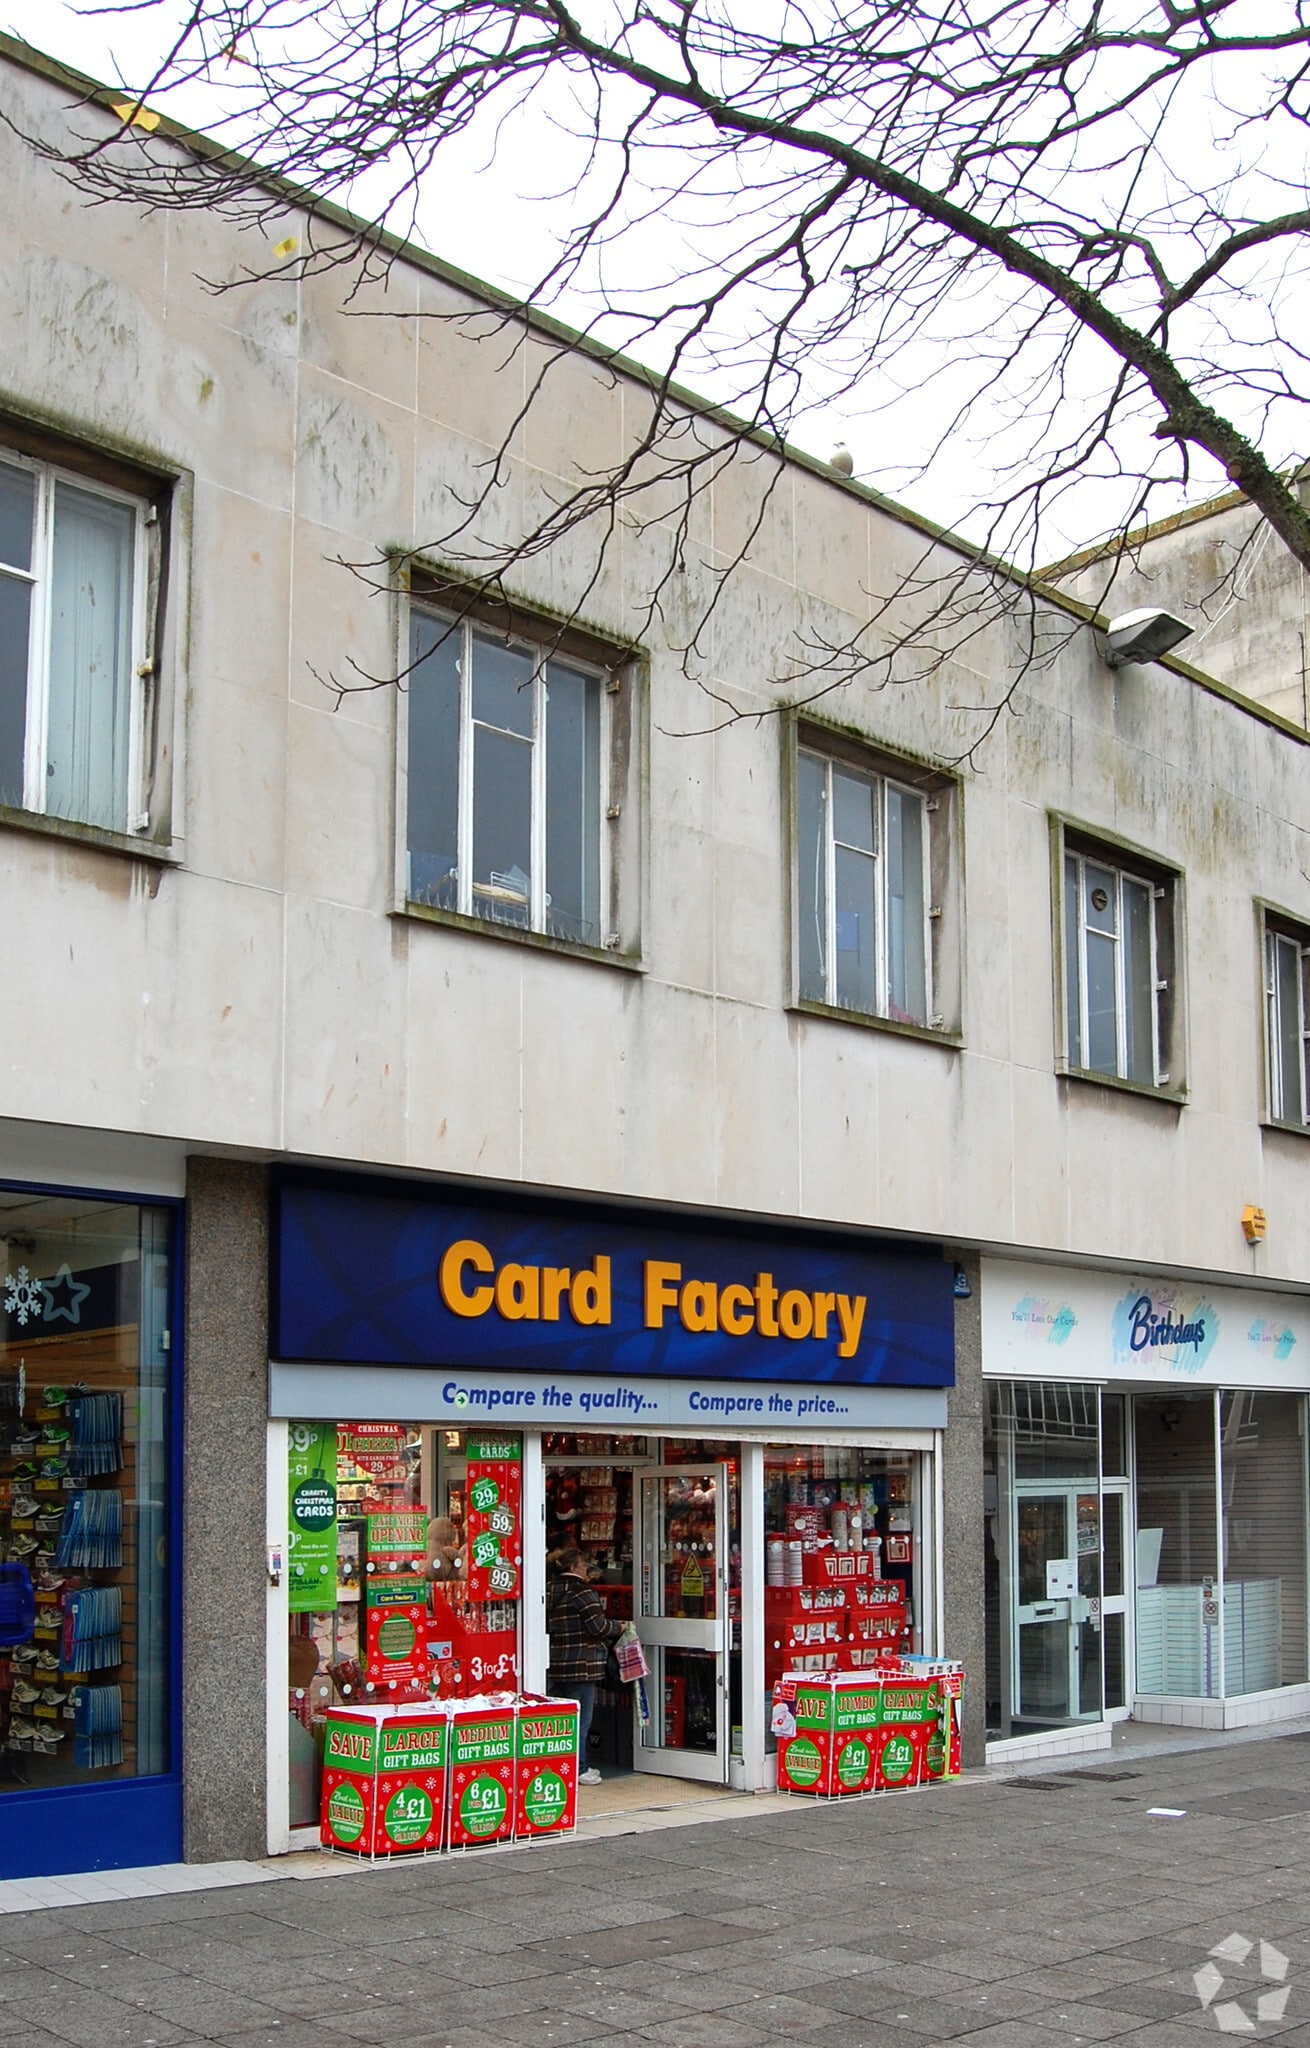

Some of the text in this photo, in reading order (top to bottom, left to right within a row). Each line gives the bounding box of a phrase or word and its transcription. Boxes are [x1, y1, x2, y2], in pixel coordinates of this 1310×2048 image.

[440, 1239, 867, 1357] Card Factory
[1047, 1314, 1059, 1324] Our
[1060, 1315, 1078, 1326] Cards
[1128, 1295, 1205, 1352] Birthdays
[542, 1385, 573, 1408] the
[579, 1388, 658, 1413] quality...
[689, 1391, 849, 1416] Compare the price...
[357, 1425, 399, 1433] CHRISTMAS
[480, 1447, 510, 1458] CARDS
[295, 1464, 308, 1475] £1
[294, 1497, 334, 1505] CHRISTMAS
[301, 1489, 328, 1497] CHARITY
[296, 1506, 334, 1517] CARDS
[371, 1515, 424, 1527] LATE NIGHT
[371, 1527, 424, 1543] OPENING
[471, 1653, 517, 1676] 3 for £1
[795, 1697, 827, 1720] AVE
[838, 1694, 876, 1712] JUMBO
[884, 1693, 923, 1709] GIANT
[838, 1712, 876, 1726] GIFT BAGS
[883, 1710, 923, 1721] GIFT BAGS
[457, 1724, 510, 1745] MEDIUM
[522, 1719, 573, 1740] SMALL
[330, 1730, 372, 1761] SAVE
[384, 1730, 440, 1752] LARGE
[523, 1739, 573, 1755] GIFT BAGS
[890, 1740, 897, 1753] 2
[457, 1742, 510, 1760] GIFT BAGS
[846, 1745, 853, 1758] 3
[852, 1749, 866, 1767] £1
[896, 1745, 910, 1762] £1
[383, 1752, 440, 1768] GIFT BAGS
[787, 1754, 820, 1770] VALUE
[470, 1783, 480, 1799] 6
[534, 1777, 543, 1793] 8
[544, 1782, 561, 1802] £1
[396, 1792, 405, 1808] 4
[481, 1787, 500, 1811] £1
[330, 1803, 363, 1823] VALUE
[406, 1797, 426, 1819] £1
